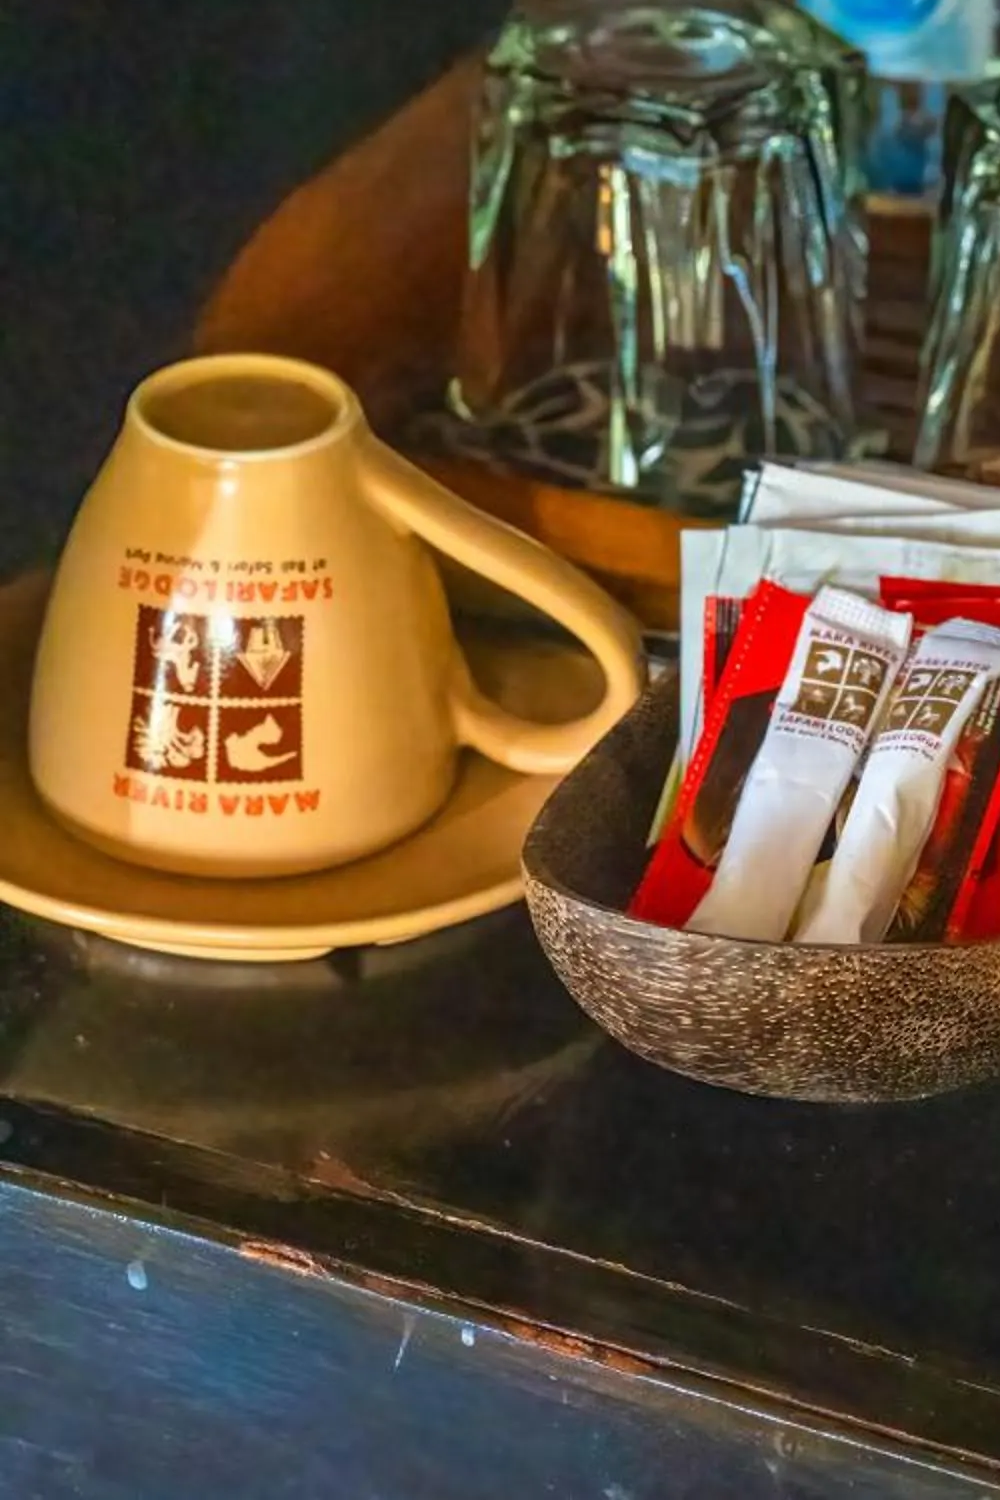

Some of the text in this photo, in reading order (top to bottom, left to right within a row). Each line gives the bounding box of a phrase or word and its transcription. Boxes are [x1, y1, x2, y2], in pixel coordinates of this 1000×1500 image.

[282, 560, 305, 575] Bali
[118, 566, 333, 604] SAFARI LODGE
[808, 628, 855, 646] MARA
[112, 772, 320, 818] MARA RIVER
